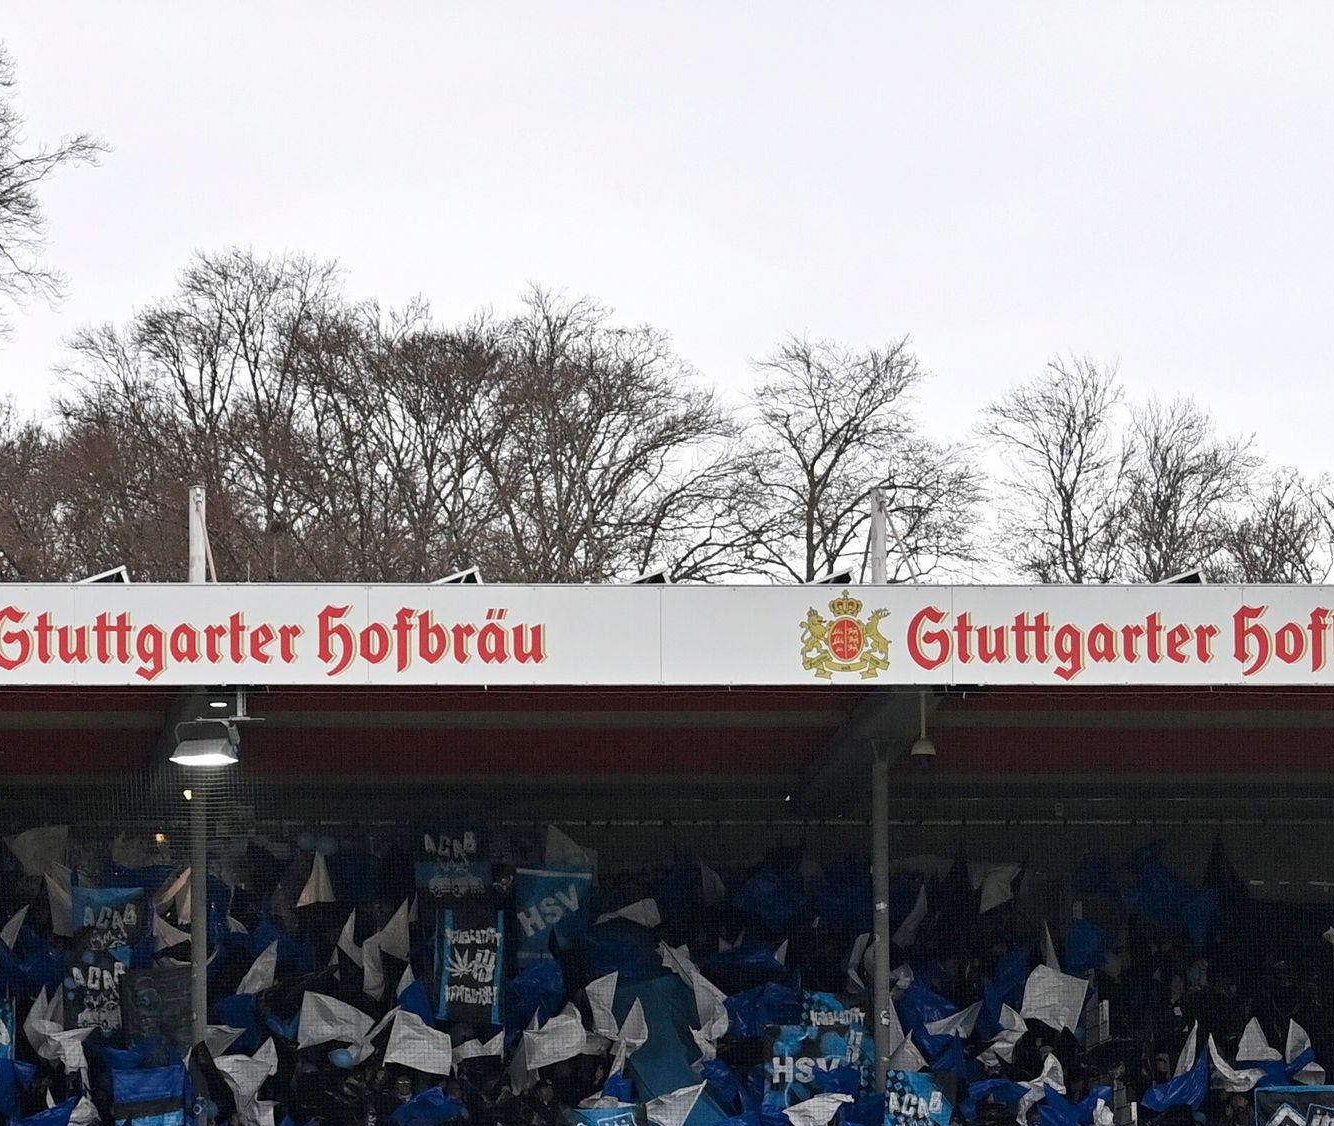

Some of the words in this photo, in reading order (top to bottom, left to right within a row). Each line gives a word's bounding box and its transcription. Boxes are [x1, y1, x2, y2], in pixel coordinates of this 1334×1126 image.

[316, 603, 548, 677] Hofbräu
[906, 605, 1221, 681] Stuttgarter
[516, 883, 580, 937] HSV
[772, 1056, 840, 1084] HSV
